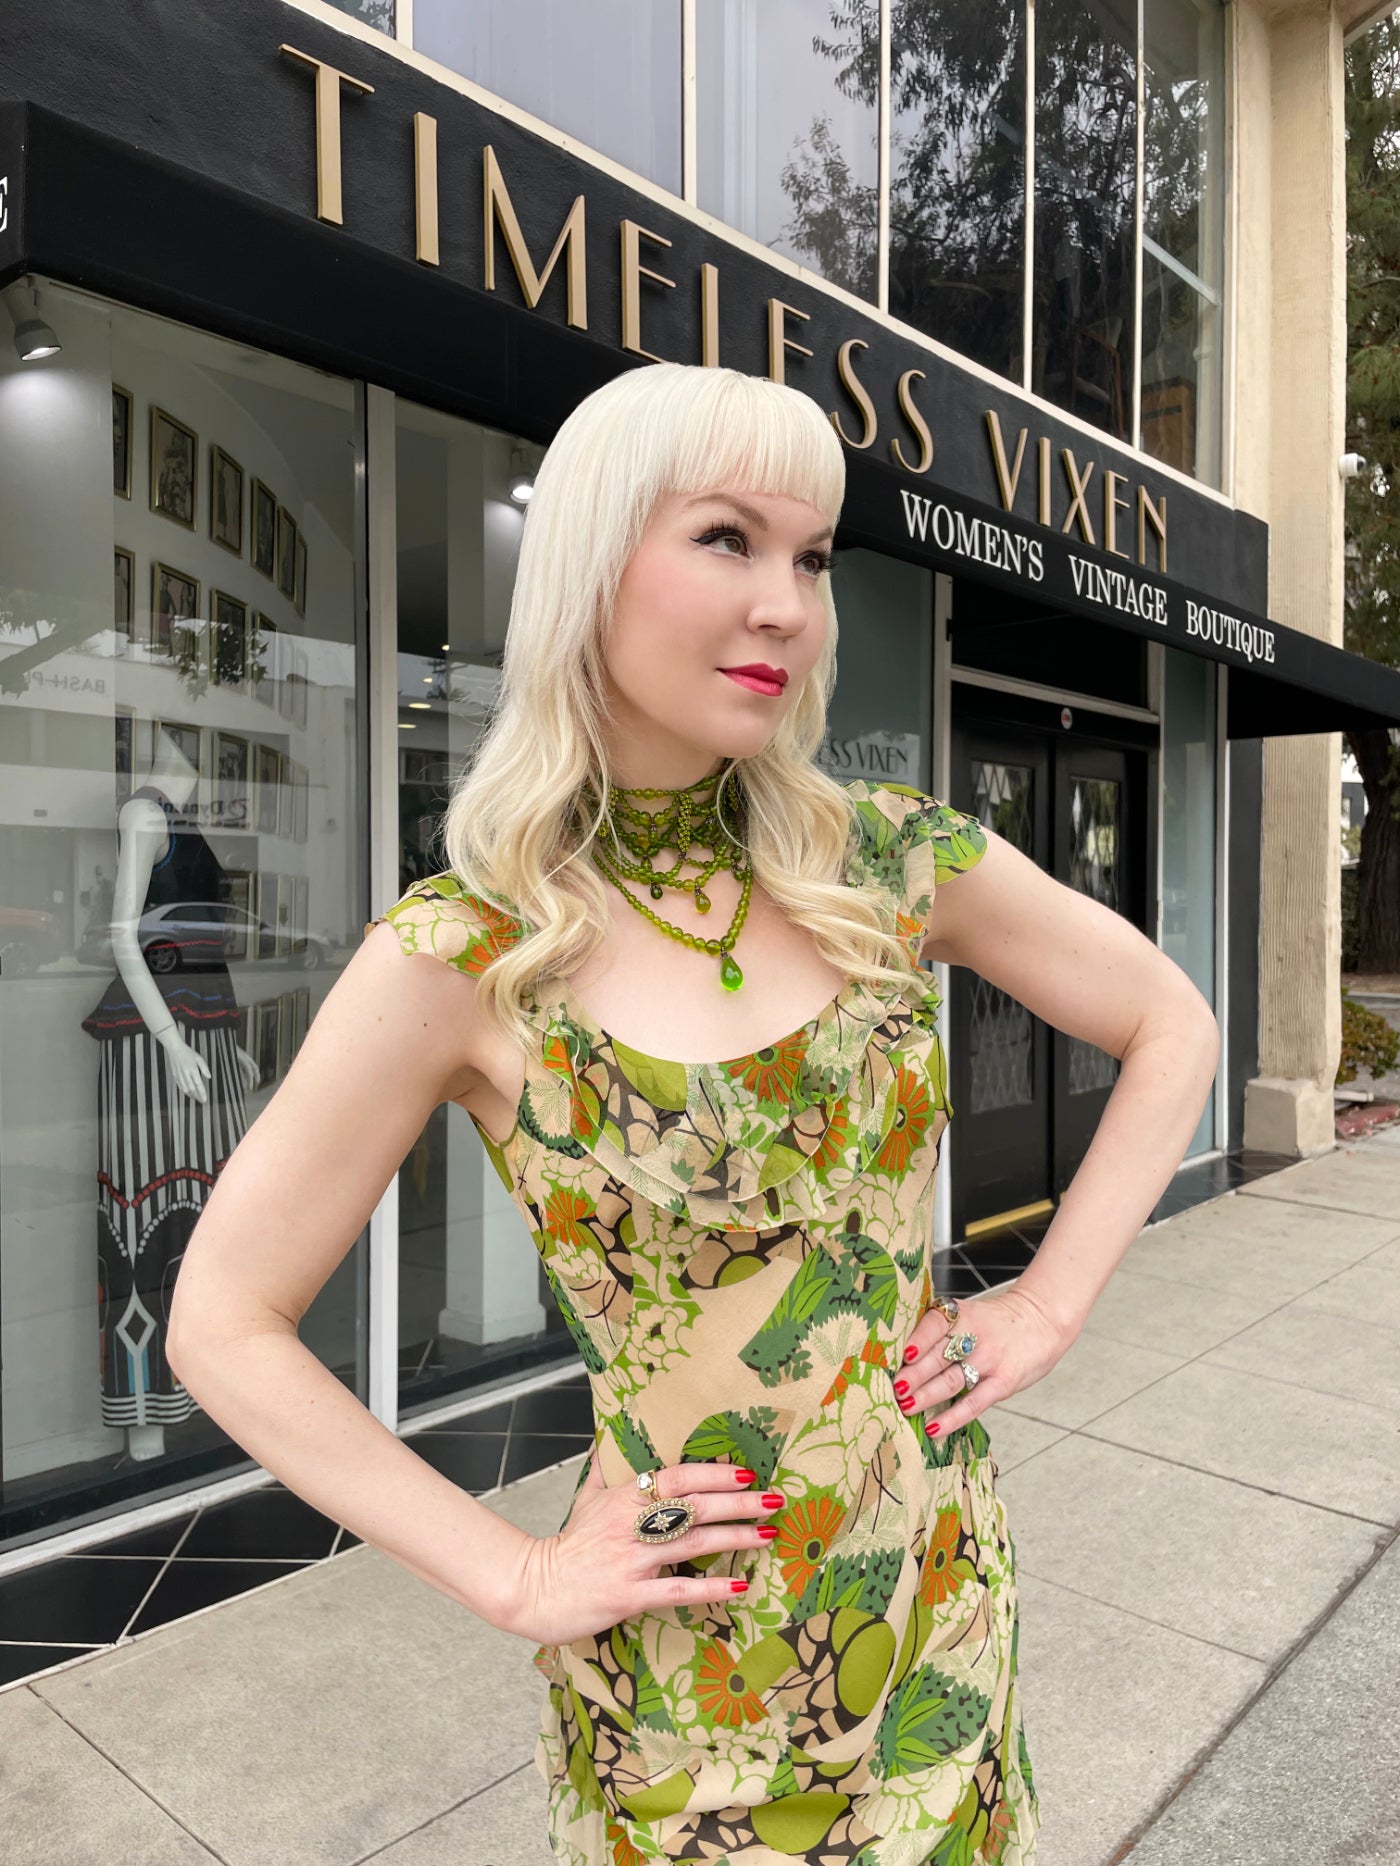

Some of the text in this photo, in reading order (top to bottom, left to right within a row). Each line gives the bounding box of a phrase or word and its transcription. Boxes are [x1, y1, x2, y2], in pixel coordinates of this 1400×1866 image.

[985, 409, 1167, 574] VIXEN
[900, 490, 1275, 663] WOMEN'S VINTAGE BOUTIQUE
[856, 742, 908, 776] VIXEN
